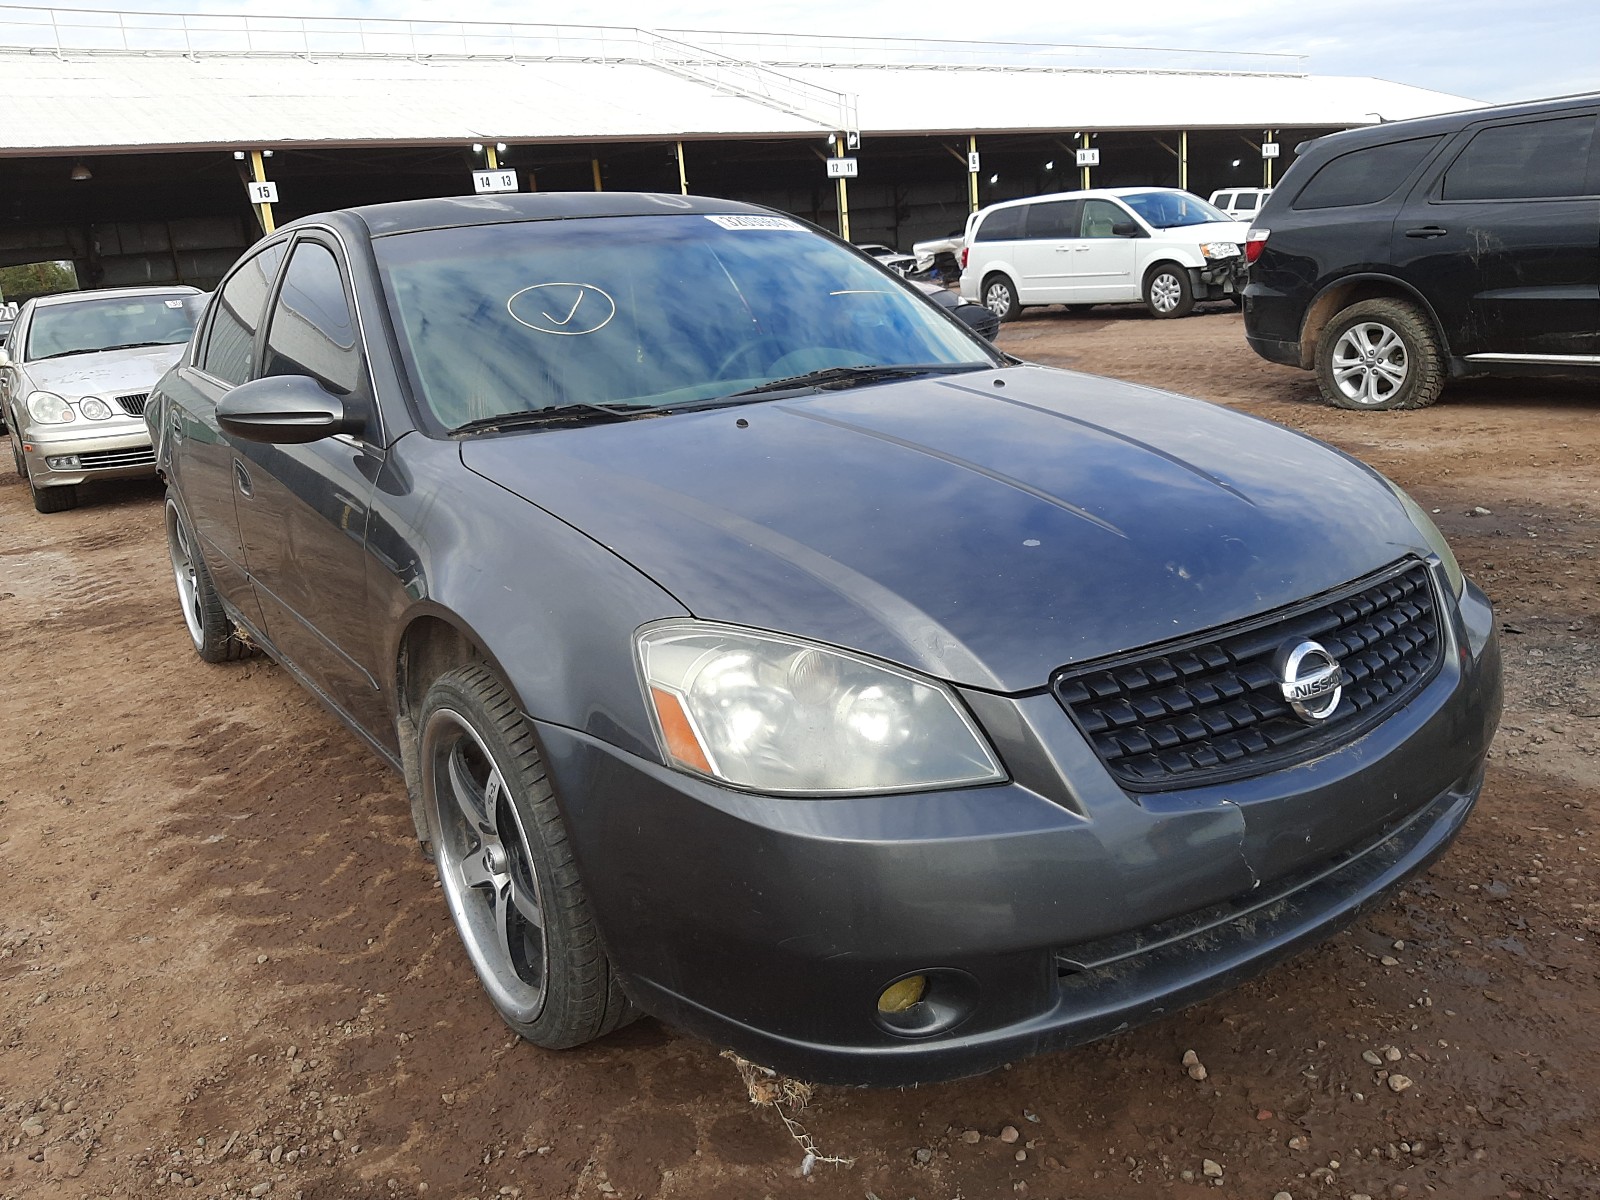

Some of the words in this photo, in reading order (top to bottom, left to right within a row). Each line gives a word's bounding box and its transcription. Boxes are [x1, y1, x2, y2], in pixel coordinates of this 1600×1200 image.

[832, 164, 839, 173] 12
[847, 163, 853, 173] 11
[480, 177, 491, 188] 14
[501, 175, 512, 187] 13
[257, 186, 271, 199] 15
[1294, 668, 1340, 698] NISSAN
